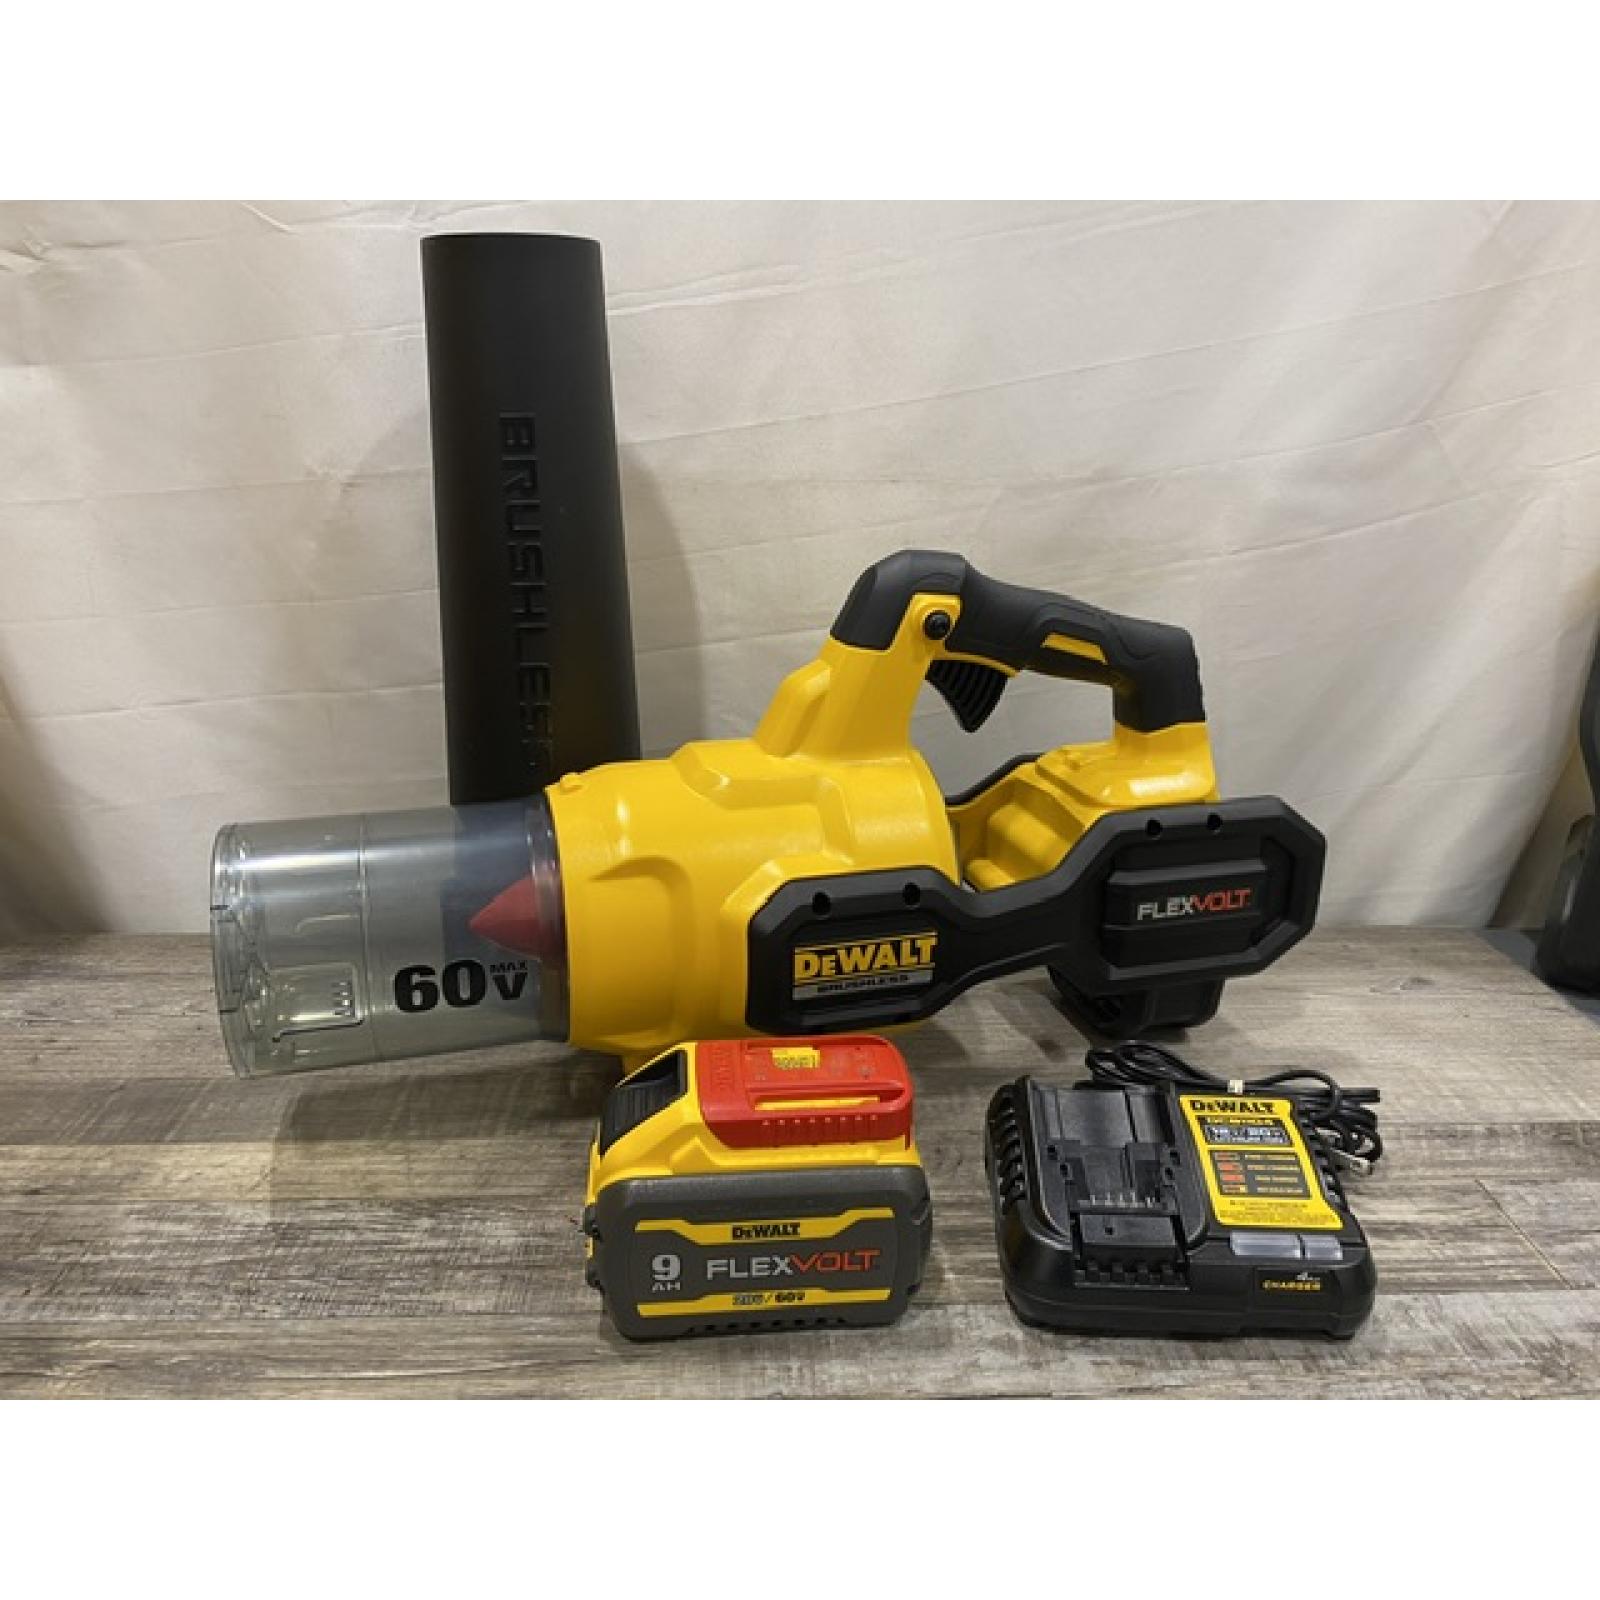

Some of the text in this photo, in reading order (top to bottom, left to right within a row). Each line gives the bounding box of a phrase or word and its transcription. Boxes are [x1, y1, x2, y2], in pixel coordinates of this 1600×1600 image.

[1136, 888, 1251, 921] FLEXVOLT
[794, 938, 936, 979] DEWALT
[732, 1222, 801, 1240] DEWALT
[651, 1249, 881, 1281] 9 FLEXVOLT
